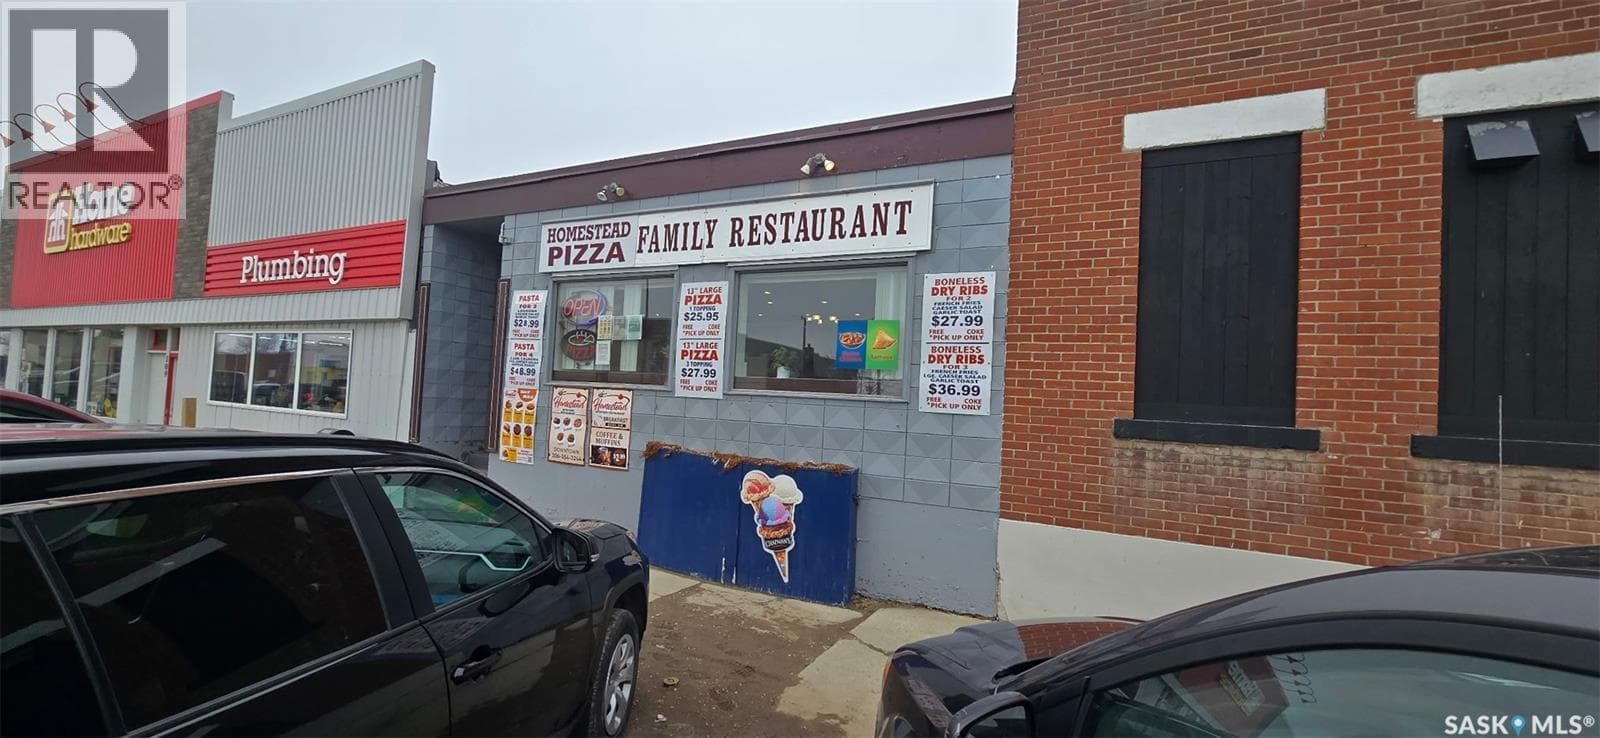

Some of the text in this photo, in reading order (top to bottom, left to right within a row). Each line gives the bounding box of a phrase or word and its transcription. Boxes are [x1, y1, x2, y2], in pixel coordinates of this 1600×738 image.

[546, 220, 631, 244] HOMESTEAD
[636, 200, 913, 255] FAMILY RESTAURANT
[69, 221, 133, 252] hardware
[547, 242, 625, 267] PIZZA
[240, 248, 348, 285] Plumbing
[934, 277, 985, 286] BONELESS
[699, 286, 722, 294] LARGE
[931, 285, 989, 297] DRY RIBS
[518, 294, 540, 302] PASTA
[684, 294, 722, 306] PIZZA
[563, 298, 602, 317] OPEN
[683, 311, 719, 322] $25.95
[931, 315, 984, 328] $27.99
[513, 343, 535, 351] PASTA
[931, 345, 982, 354] BONELESS
[680, 349, 719, 361] PIZZA
[927, 354, 985, 365] DRY RIBS
[510, 367, 536, 377] $48.99
[680, 367, 717, 378] $27.99
[928, 383, 981, 397] $36.99
[595, 431, 618, 440] COFFEE
[595, 438, 621, 446] MUFFINS
